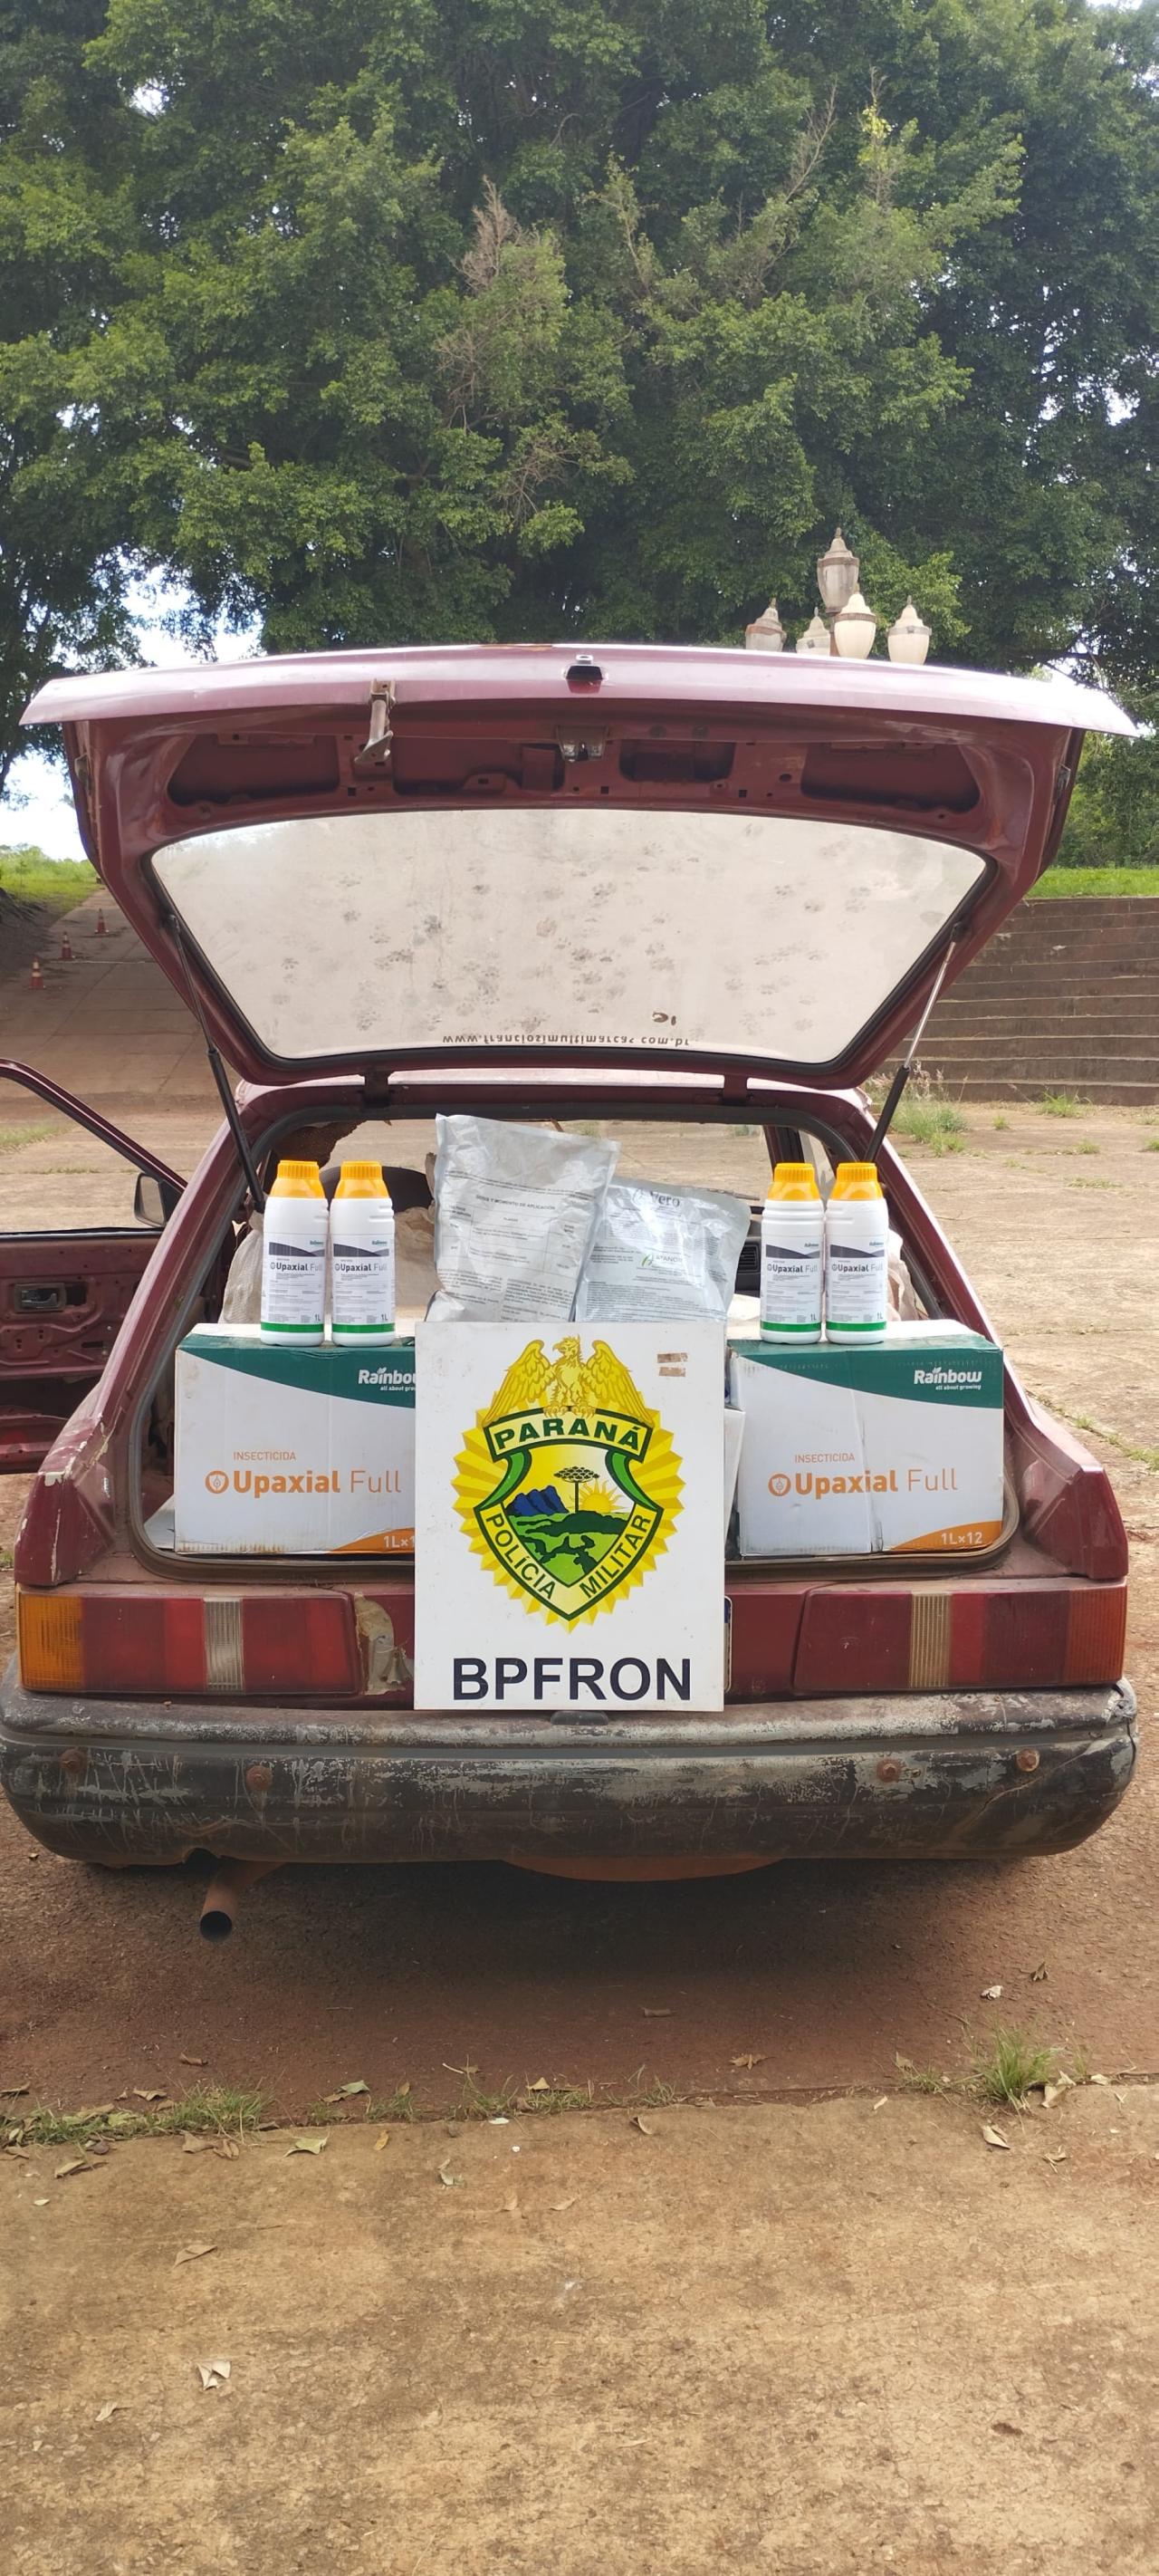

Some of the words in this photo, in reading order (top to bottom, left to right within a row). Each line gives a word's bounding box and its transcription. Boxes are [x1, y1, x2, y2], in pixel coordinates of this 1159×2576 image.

[275, 1263, 308, 1272] Upaxial
[340, 1264, 371, 1273] Upaxial
[772, 1264, 803, 1273] Upaxial
[838, 1264, 869, 1273] Upaxial
[358, 1367, 416, 1384] Rainbo
[914, 1367, 982, 1384] Rainbow
[494, 1418, 639, 1450] PARANÁ
[234, 1451, 297, 1461] INSECTICIDA
[795, 1453, 856, 1463] INSECTICIDA
[234, 1470, 341, 1498] Upaxial
[350, 1470, 402, 1494] Full
[795, 1470, 899, 1499] Upaxial
[907, 1468, 958, 1492] Full
[486, 1512, 558, 1600] POLÍCIA
[580, 1514, 652, 1600] MILITAR
[454, 1657, 691, 1702] BPFRON
